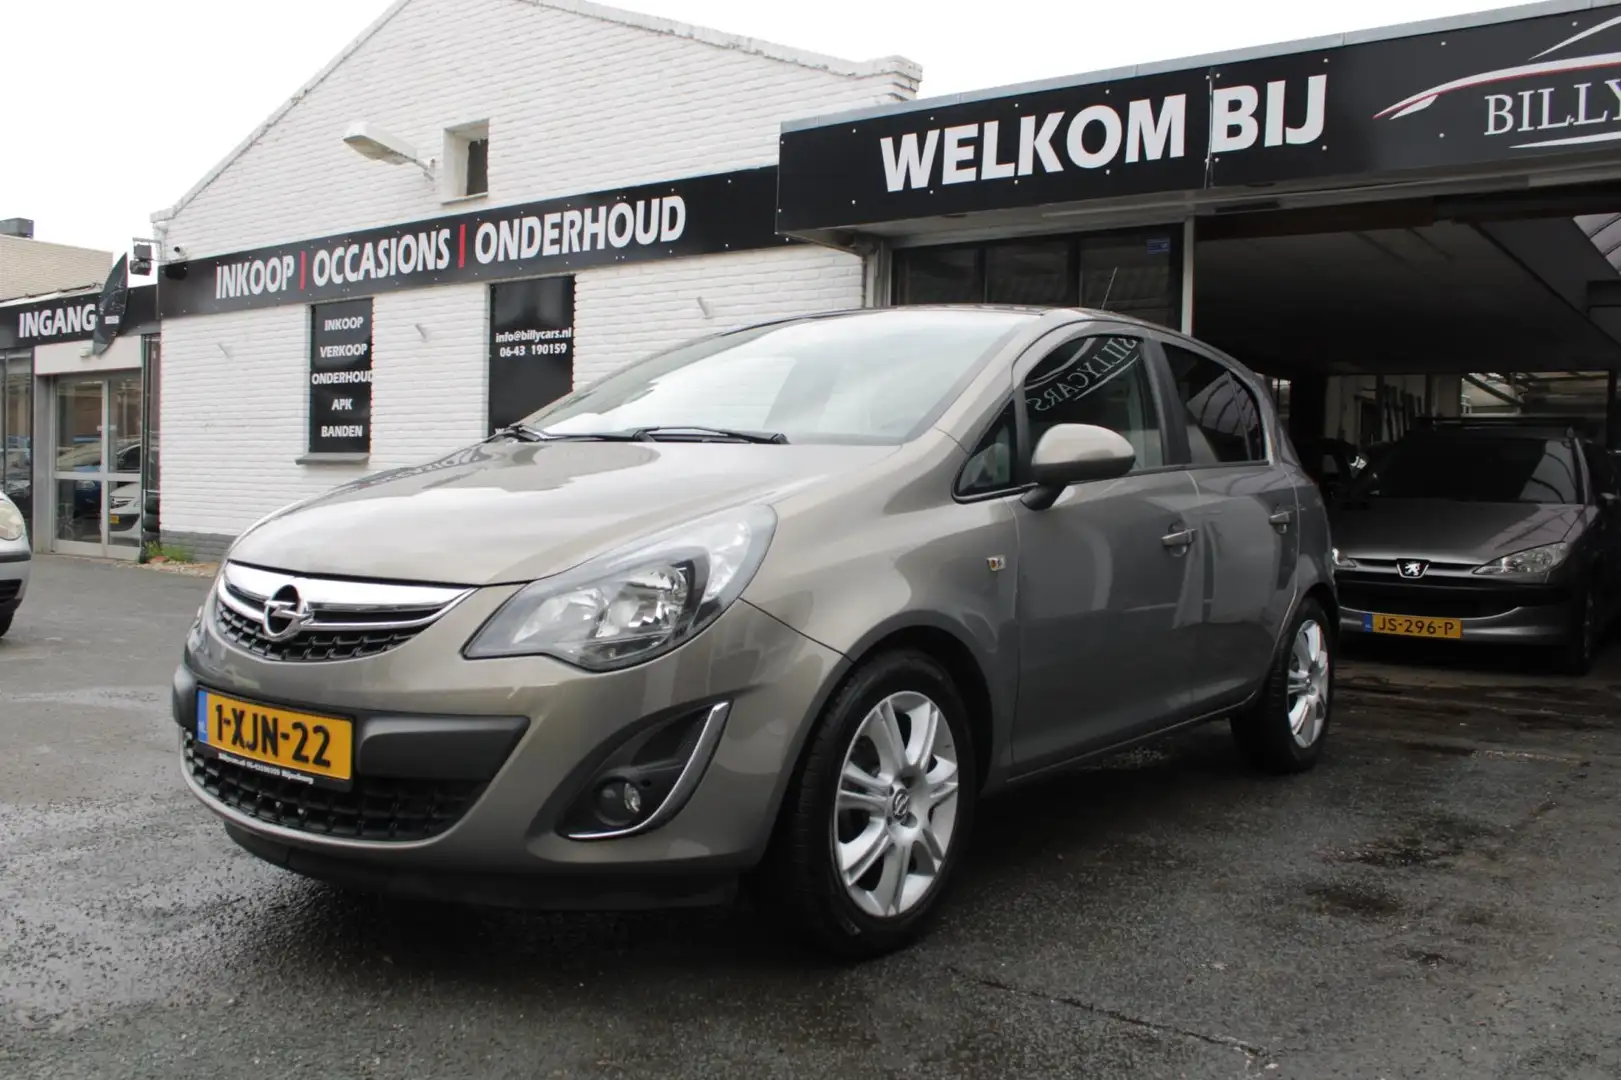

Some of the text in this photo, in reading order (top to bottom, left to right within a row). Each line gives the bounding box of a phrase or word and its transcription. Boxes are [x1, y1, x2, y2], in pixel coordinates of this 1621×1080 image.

[880, 74, 1327, 192] WELKOM BIJ
[215, 195, 686, 299] INKOOP OCCASIONS ONDERHOUD
[18, 303, 96, 338] INGANG
[324, 316, 364, 331] INKOOP
[495, 327, 572, 343] info@billycars.nl
[320, 343, 368, 358] VERKOOP
[499, 343, 567, 357] 06-43 190159
[311, 370, 373, 385] ONDERHOUD
[331, 398, 352, 411] APK
[321, 425, 363, 437] BANDEN
[1378, 616, 1454, 635] JS-296-P
[215, 704, 331, 768] 1-XJN-22
